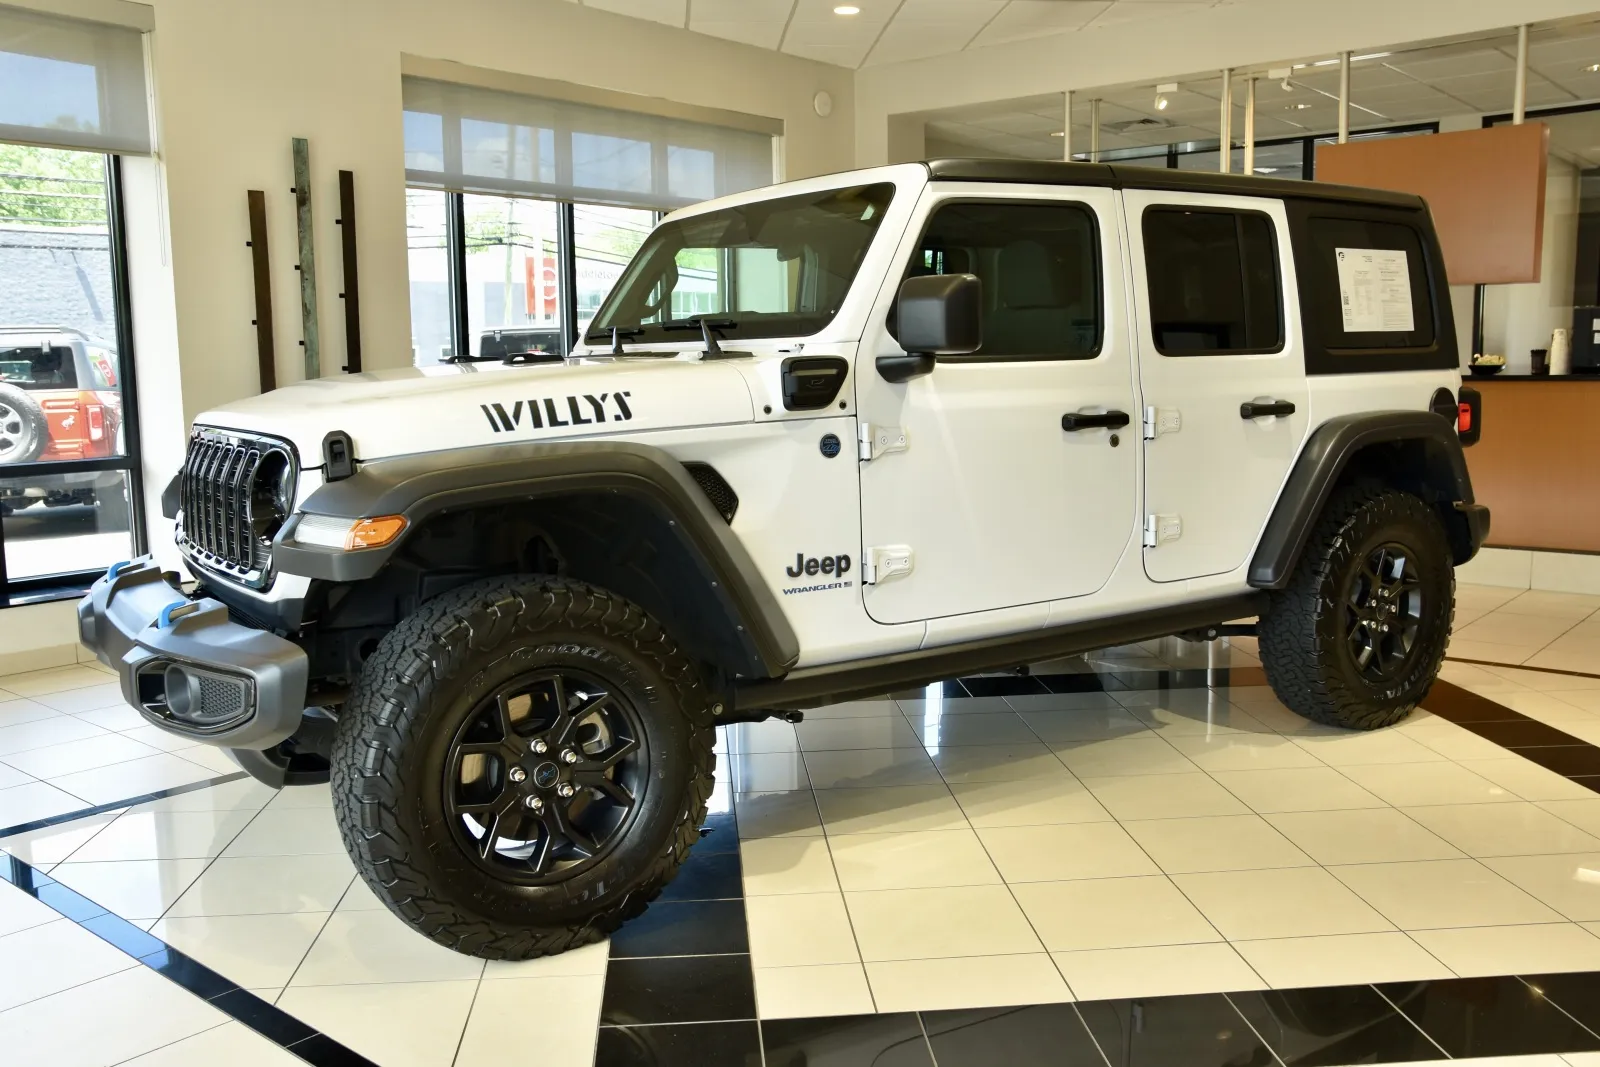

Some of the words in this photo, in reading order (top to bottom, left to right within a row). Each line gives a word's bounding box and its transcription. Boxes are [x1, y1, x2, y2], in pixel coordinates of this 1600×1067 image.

[479, 391, 633, 433] WILLYS
[786, 552, 852, 578] Jeep
[782, 582, 842, 596] WRANGLER
